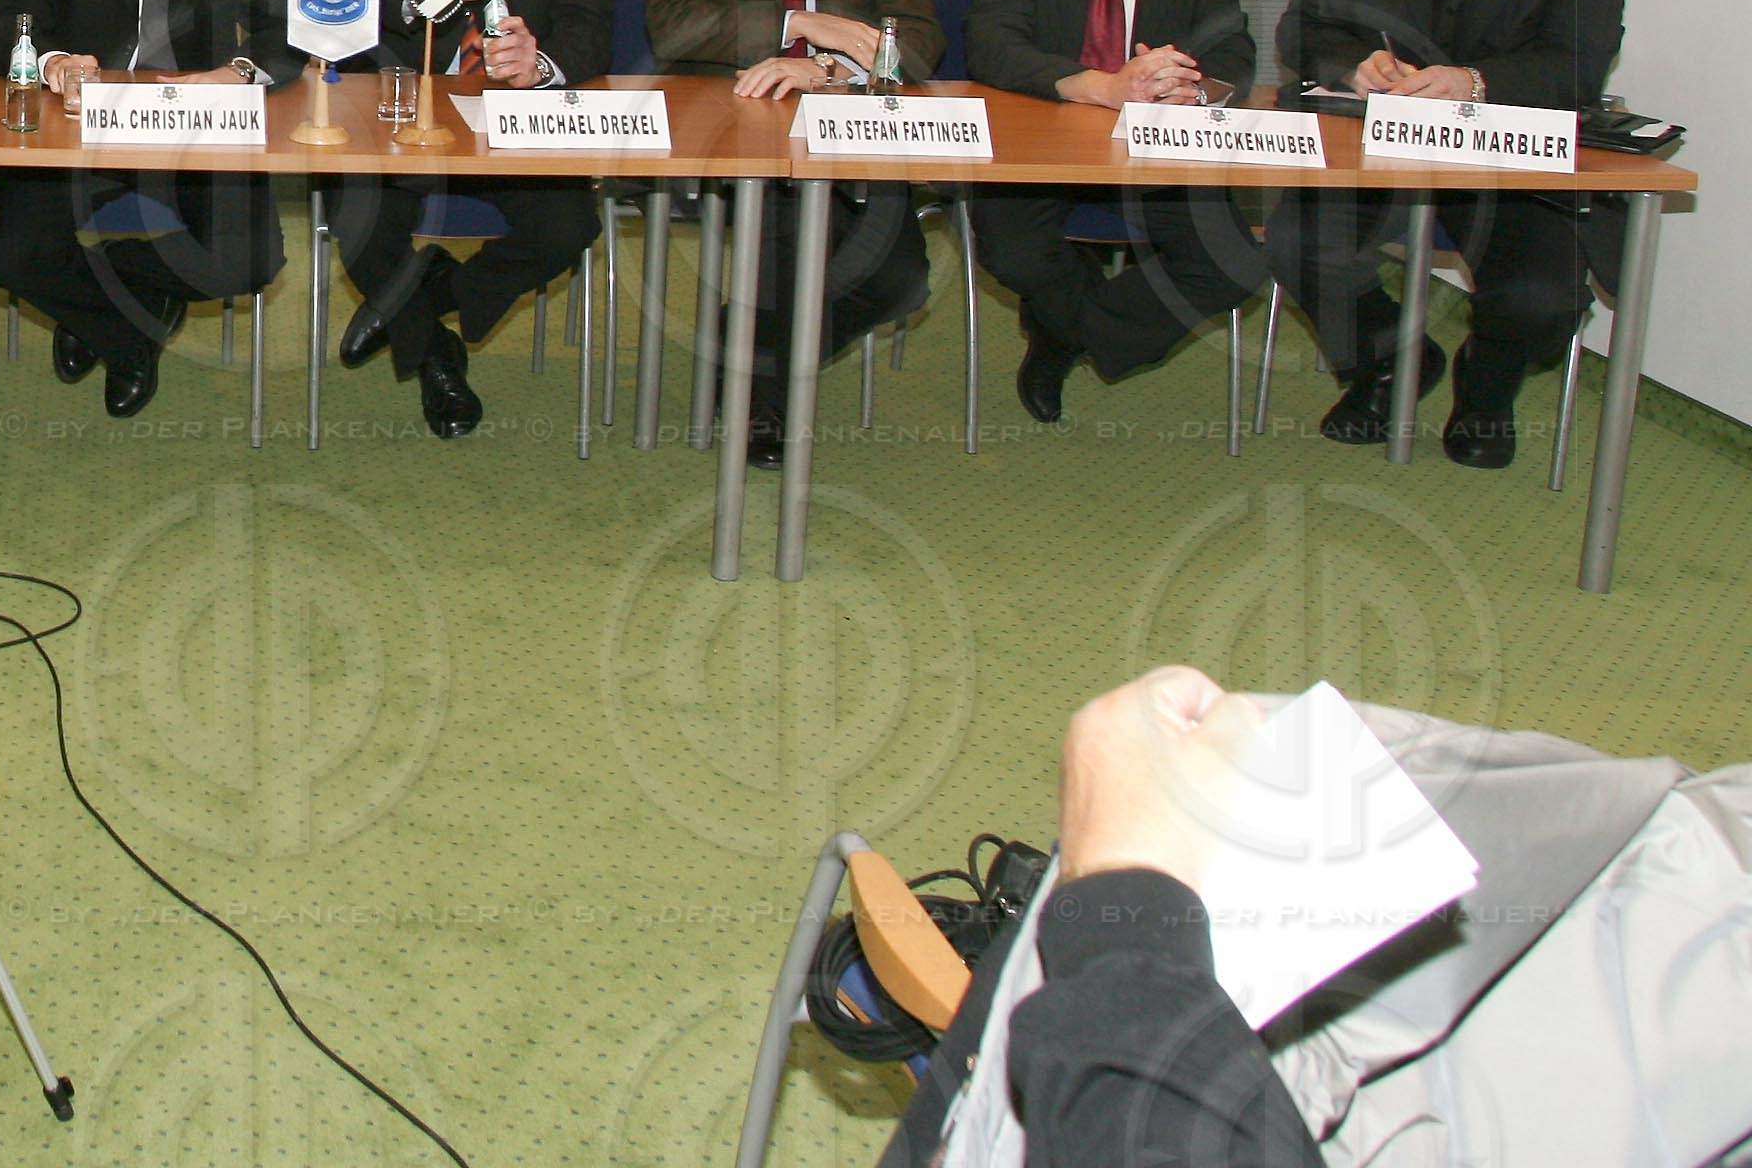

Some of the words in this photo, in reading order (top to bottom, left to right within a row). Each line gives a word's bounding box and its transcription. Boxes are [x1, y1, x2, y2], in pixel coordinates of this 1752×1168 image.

[86, 109, 124, 129] MBA.
[129, 109, 213, 130] CHRISTIAN
[220, 110, 260, 130] JAUK
[499, 114, 524, 134] DR.
[528, 114, 596, 135] MICHAEL
[600, 114, 659, 135] DREXEL
[818, 119, 842, 140] DR.
[846, 119, 898, 141] STEFAN
[903, 121, 980, 143] FATTINGER
[1132, 126, 1189, 147] GERALD
[1195, 130, 1318, 155] STOCKENHUBER
[1372, 119, 1464, 149] GERHARD
[1472, 129, 1568, 159] MARBLER
